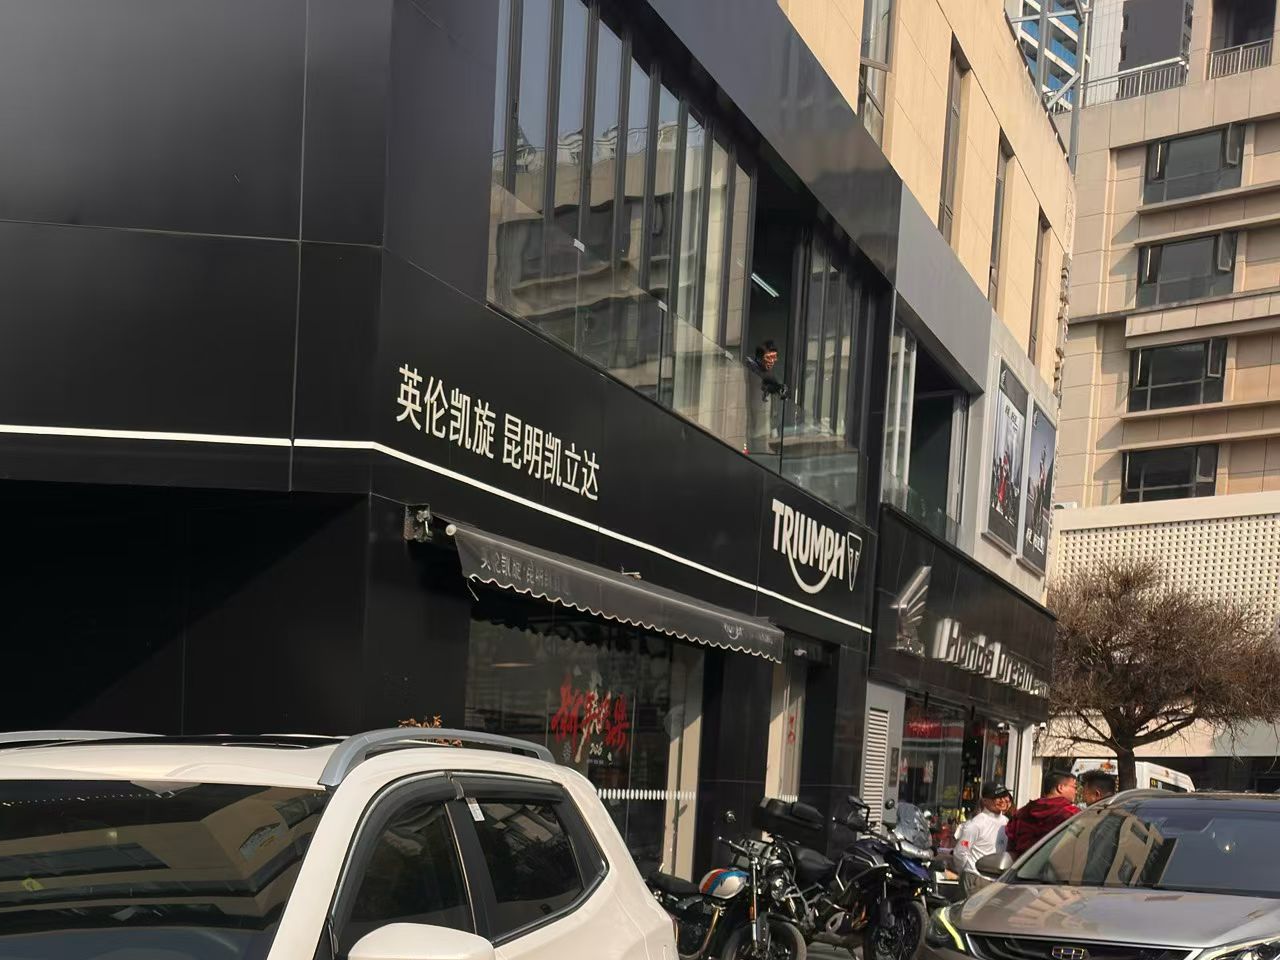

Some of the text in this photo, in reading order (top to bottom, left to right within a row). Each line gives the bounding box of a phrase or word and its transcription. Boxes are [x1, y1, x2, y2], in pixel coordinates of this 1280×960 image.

[396, 364, 600, 501] 英伦凯旋 昆明凯立达
[772, 498, 846, 592] TRIUMPH
